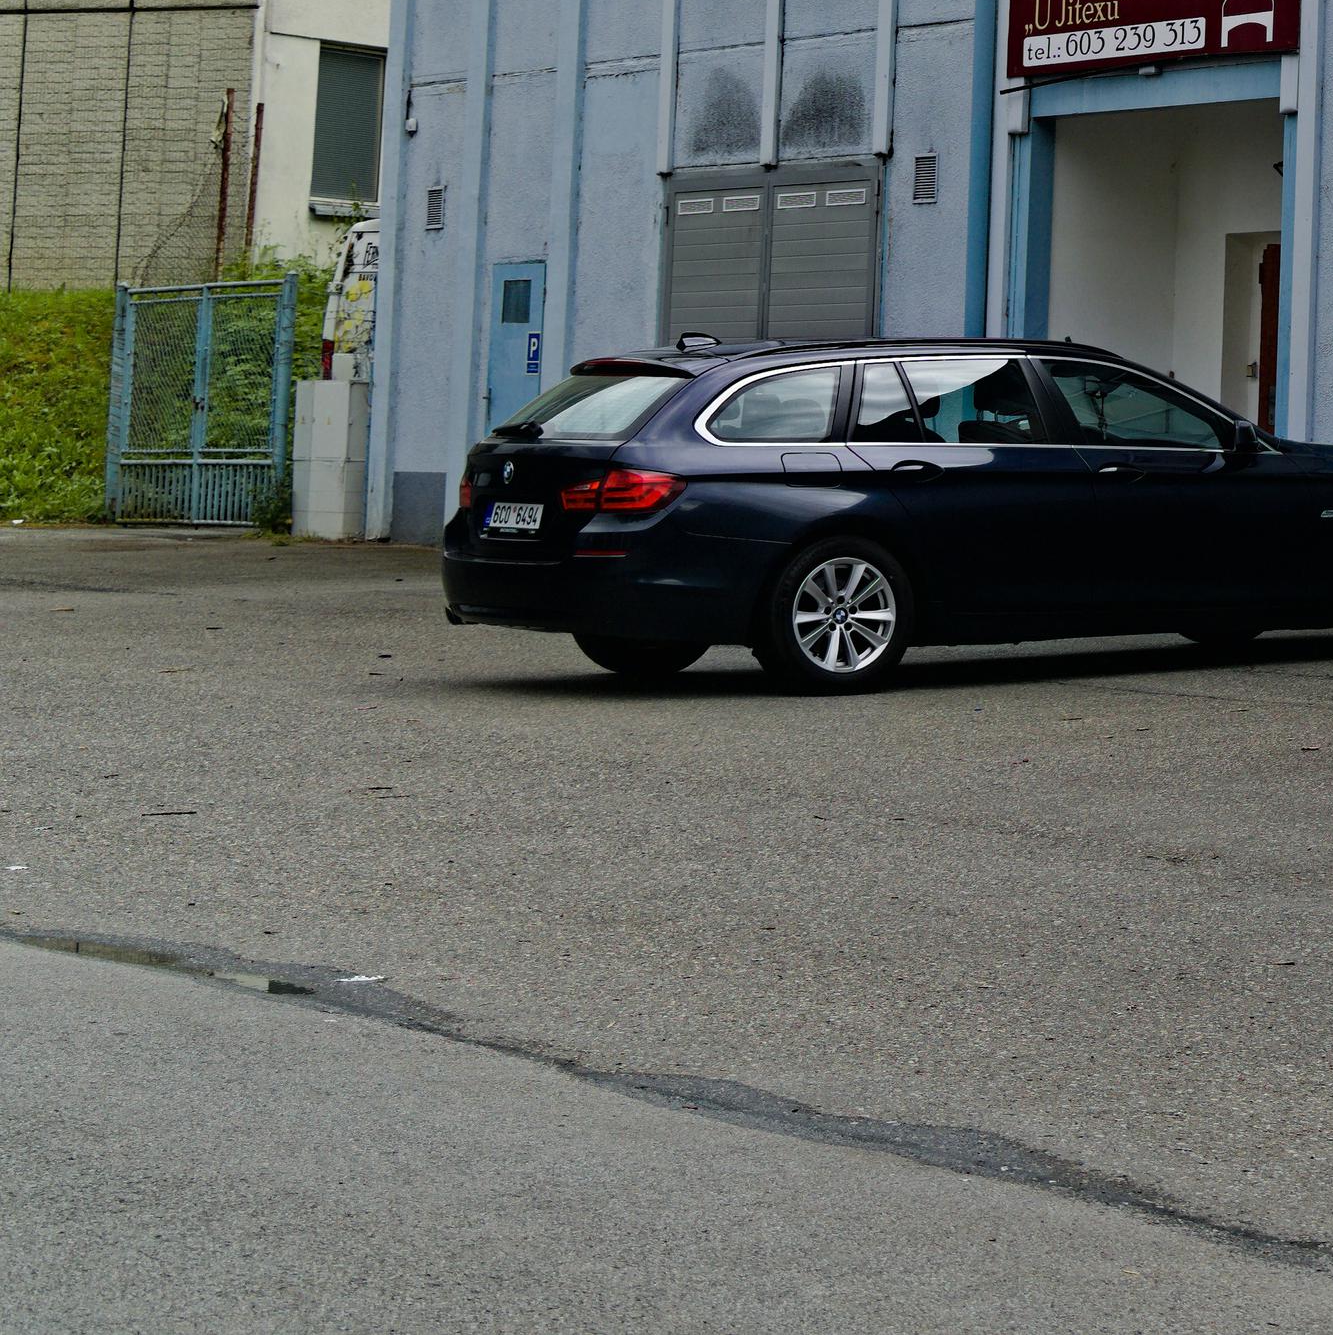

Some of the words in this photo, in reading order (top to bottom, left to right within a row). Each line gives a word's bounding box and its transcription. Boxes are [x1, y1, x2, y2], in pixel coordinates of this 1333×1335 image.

[1027, 37, 1061, 61] tel.:
[1065, 30, 1106, 57] 603
[1114, 25, 1156, 52] 239
[1163, 19, 1201, 47] 313
[530, 337, 538, 358] P
[516, 506, 539, 526] 6494
